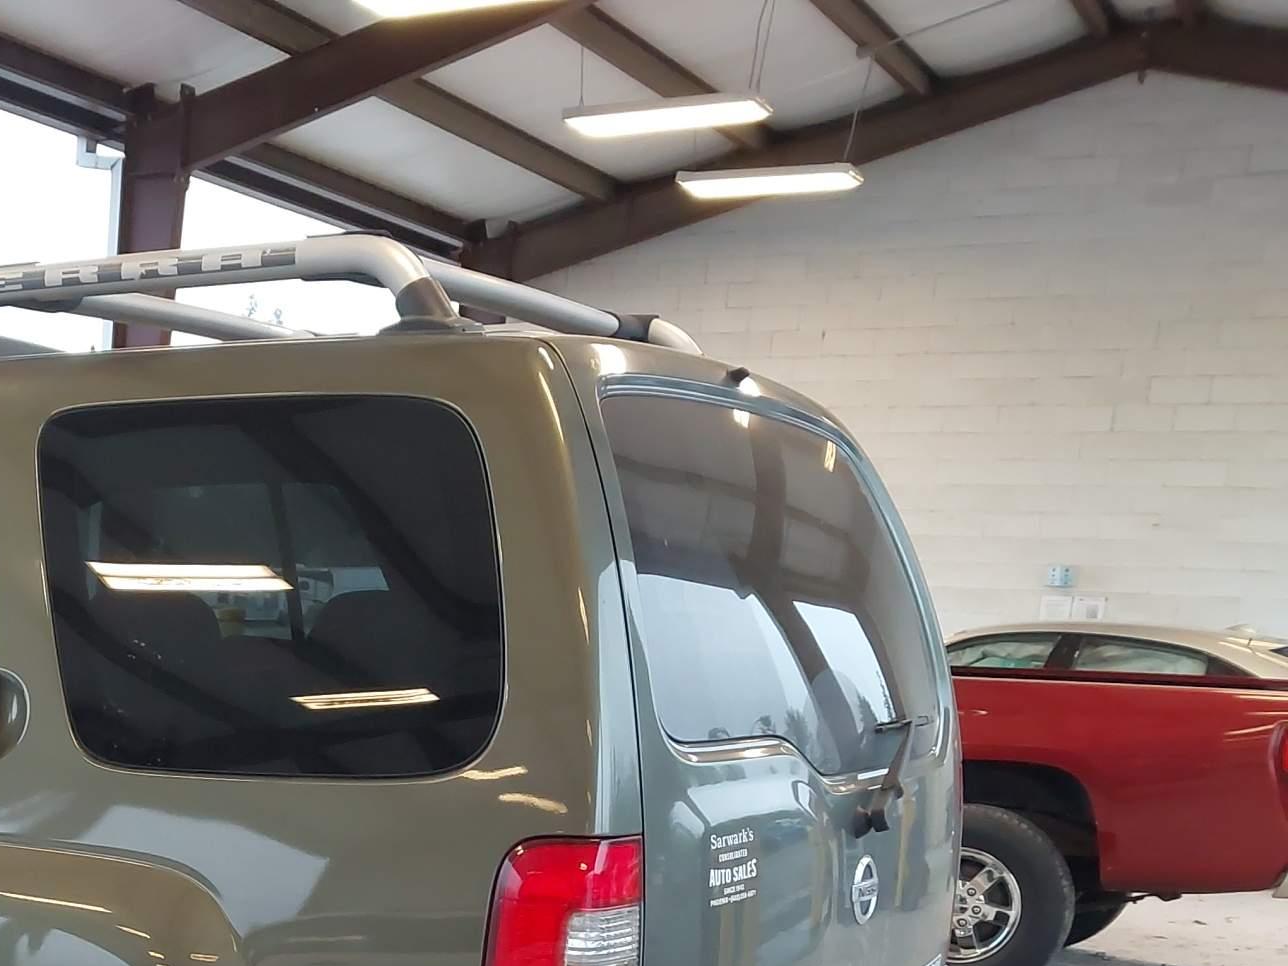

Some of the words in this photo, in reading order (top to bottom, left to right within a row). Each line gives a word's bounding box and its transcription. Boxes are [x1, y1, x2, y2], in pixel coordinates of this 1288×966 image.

[710, 827, 754, 849] Sarwark's
[709, 868, 732, 888] AUTO
[732, 858, 757, 882] SALES
